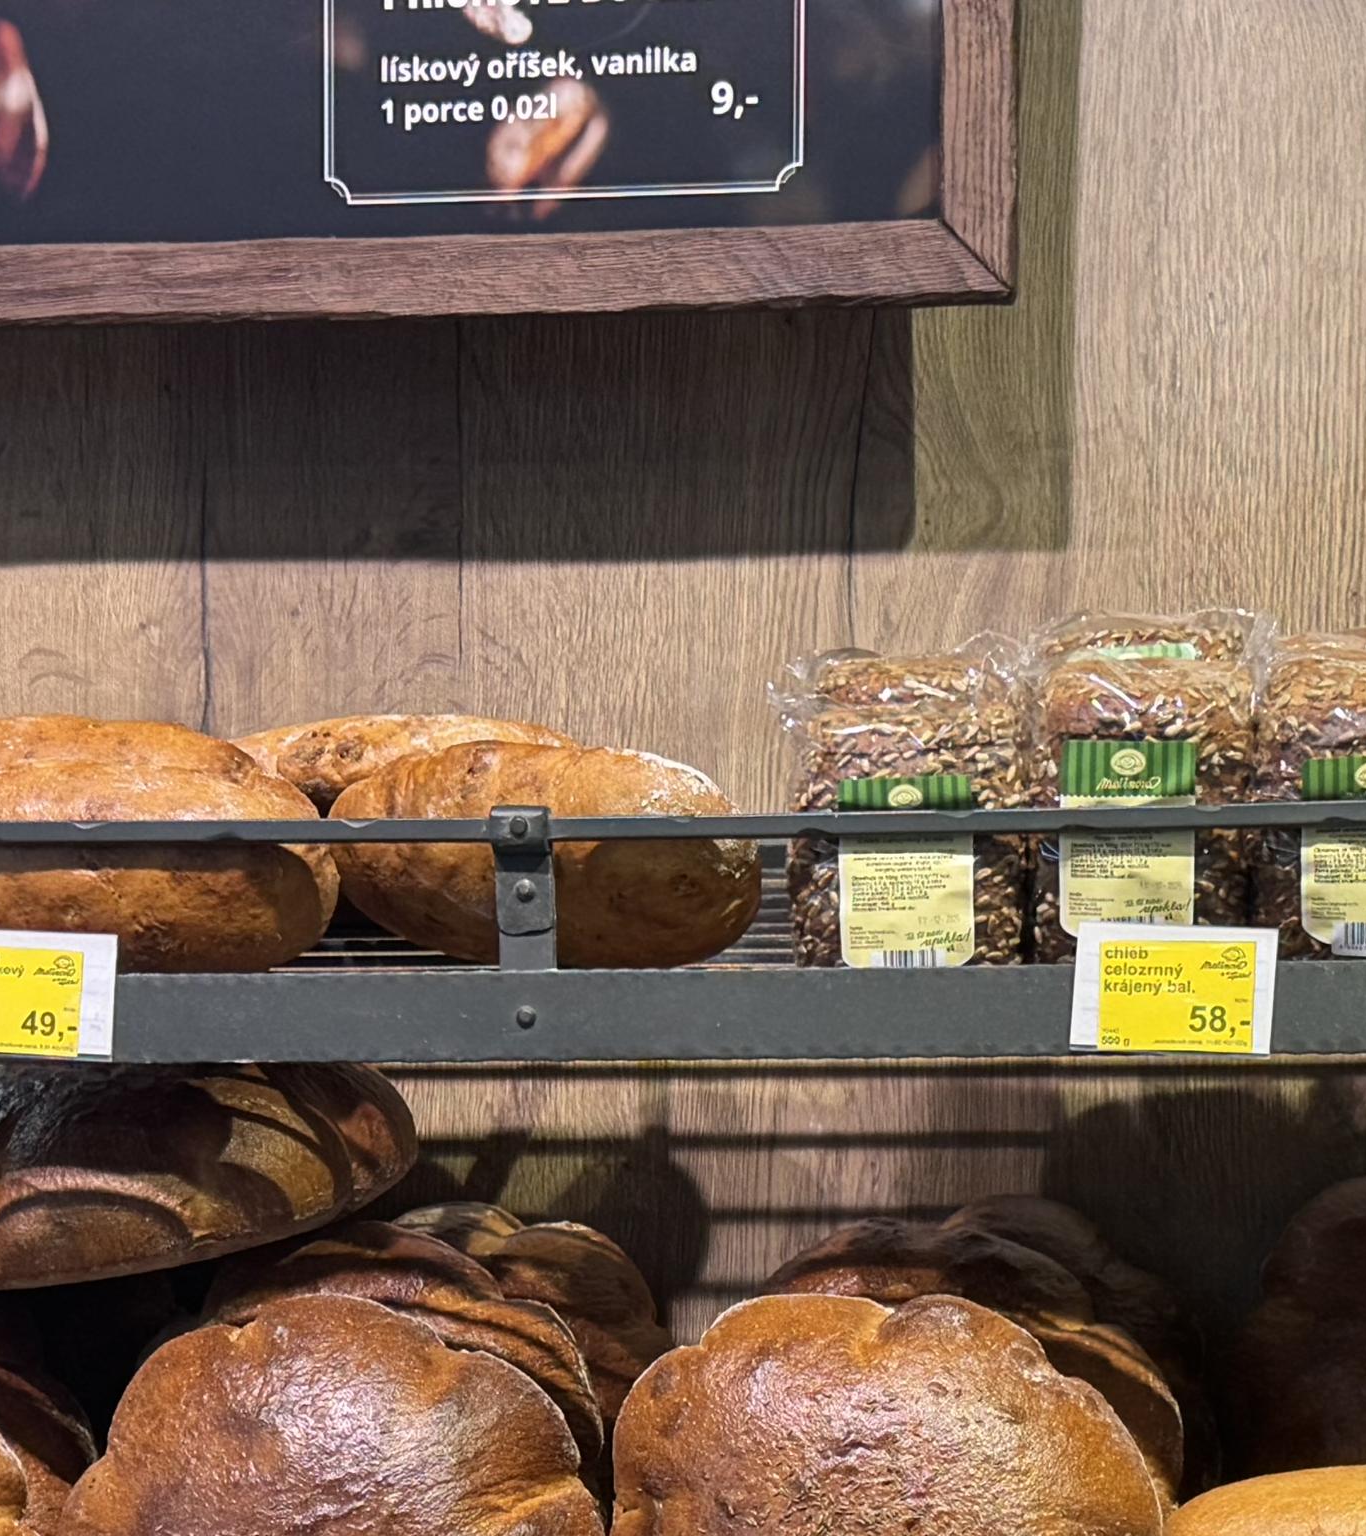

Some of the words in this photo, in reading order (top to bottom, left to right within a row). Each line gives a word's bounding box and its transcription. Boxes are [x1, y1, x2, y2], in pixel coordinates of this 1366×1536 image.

[380, 54, 479, 86] lískový
[488, 50, 583, 80] oříšek,
[591, 46, 697, 76] vanilka
[381, 99, 394, 124] 1
[404, 96, 484, 130] porce
[491, 92, 557, 123] 0,02l
[710, 80, 759, 119] 9,-
[1105, 946, 1149, 959] chléb
[1104, 963, 1183, 979] celozrnný
[1103, 979, 1163, 996] krájený
[21, 1010, 78, 1042] 49,-
[1188, 1004, 1251, 1037] 58,-
